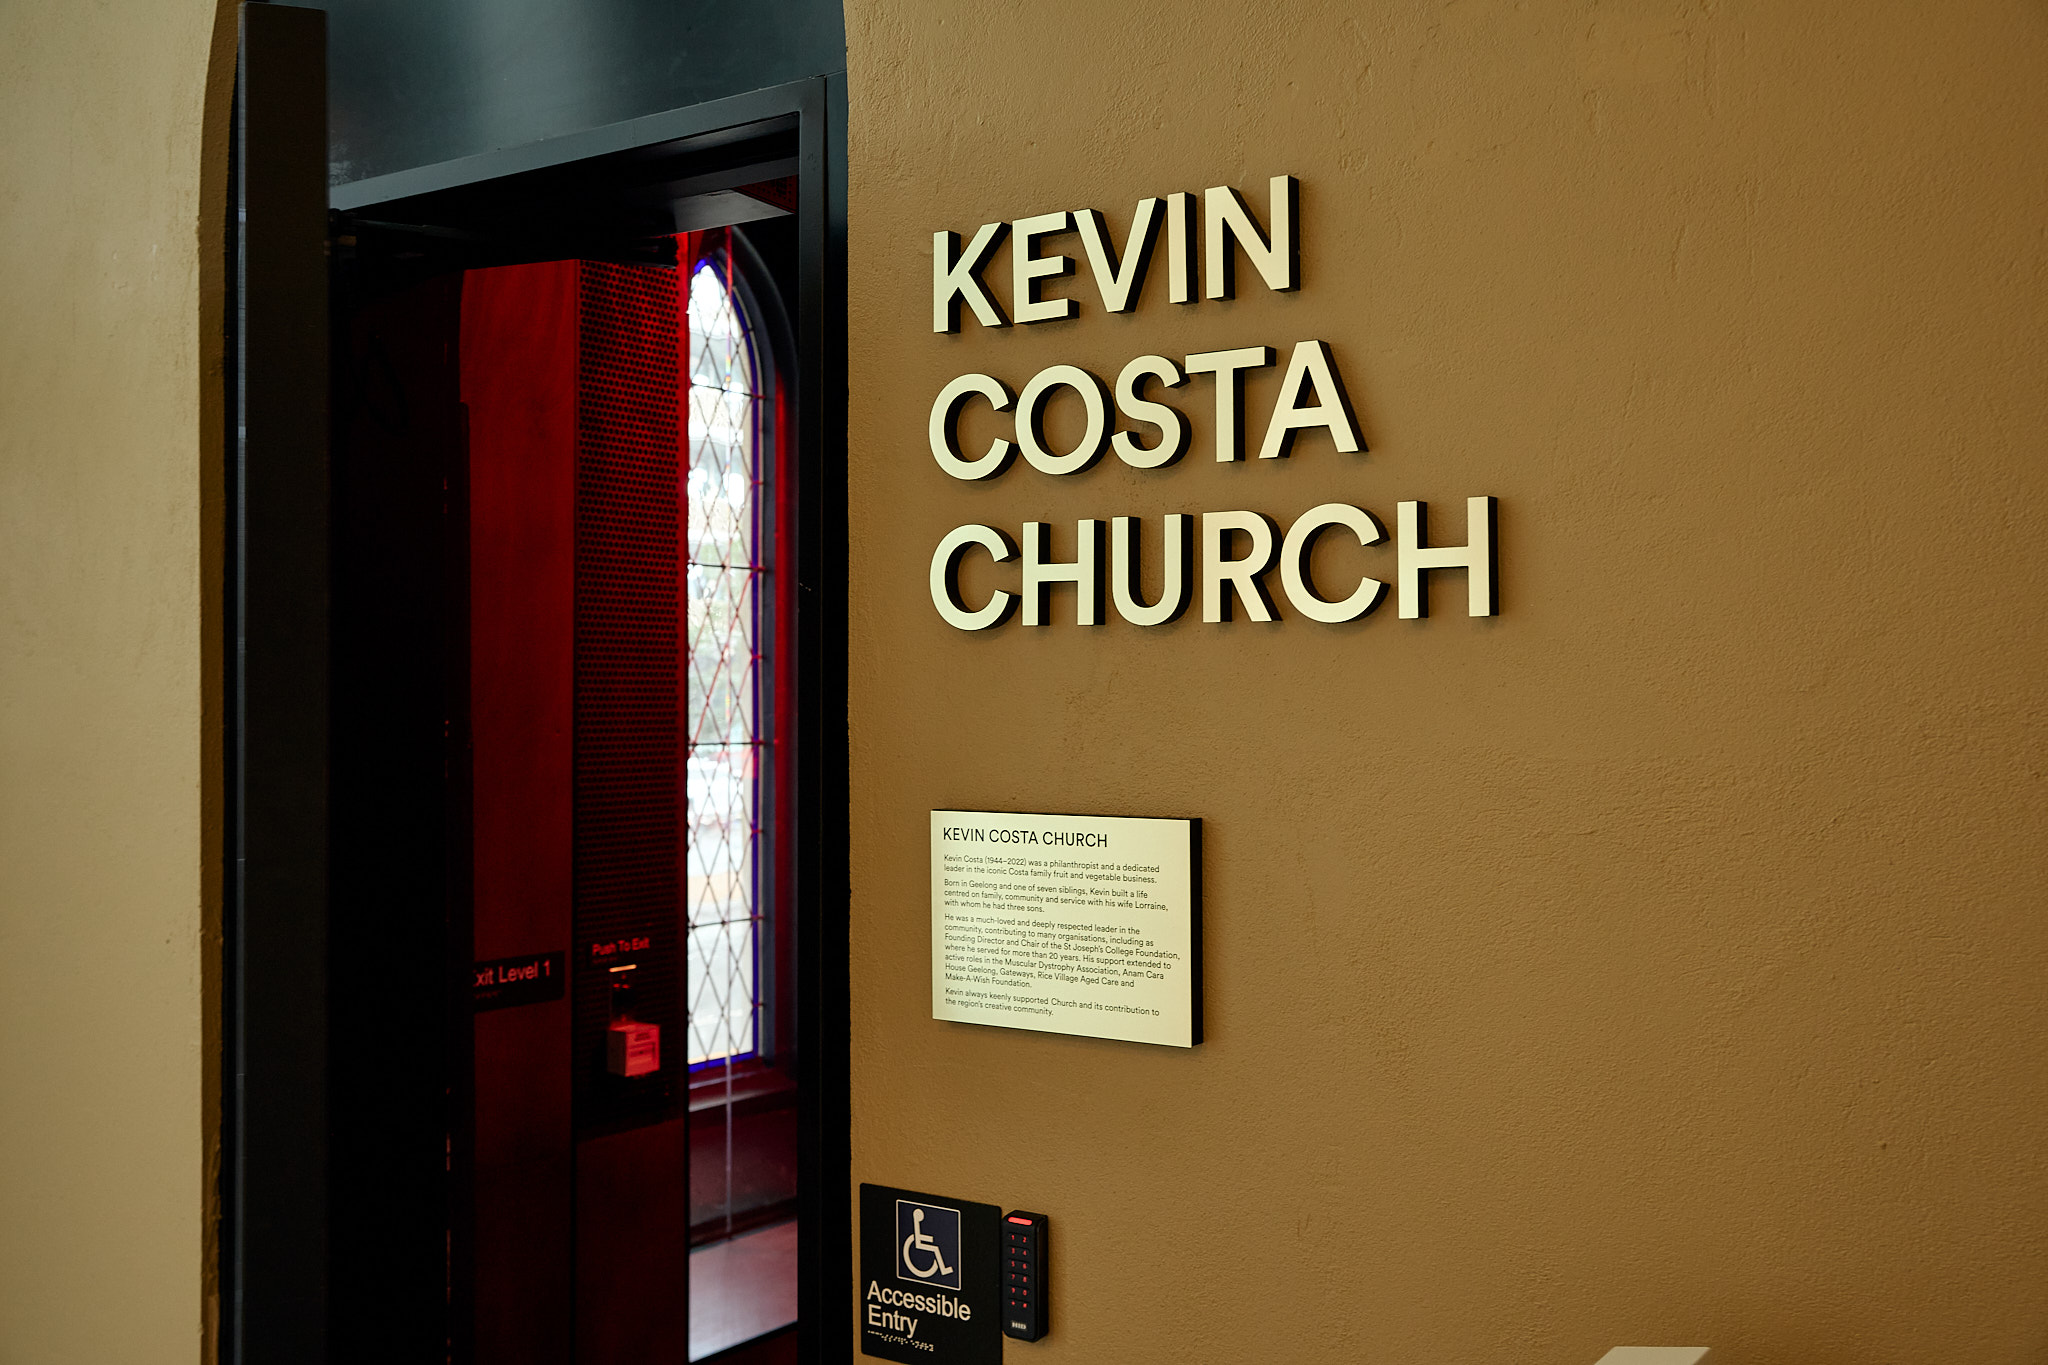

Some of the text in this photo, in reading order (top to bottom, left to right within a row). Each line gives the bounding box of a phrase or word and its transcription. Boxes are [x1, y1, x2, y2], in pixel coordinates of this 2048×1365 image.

[932, 174, 1290, 333] KEVIN
[928, 339, 1359, 481] COSTA
[929, 496, 1491, 631] CHURCH
[943, 827, 1107, 847] KEVIN COSTA CHURCH
[944, 854, 961, 862] Kevin
[963, 855, 983, 863] Costa
[1049, 859, 1099, 871] philanthropist
[1100, 862, 1114, 870] and
[1122, 863, 1159, 873] dedicated
[944, 863, 964, 872] leader
[973, 865, 985, 873] the
[986, 866, 1006, 874] iconic
[1008, 867, 1028, 876] Costa
[1030, 868, 1051, 879] family
[1053, 869, 1068, 878] fruit
[1070, 870, 1083, 879] and
[1084, 871, 1121, 883] vegetable
[1122, 873, 1156, 883] business.
[944, 878, 959, 886] Born
[961, 879, 967, 887] in
[968, 880, 997, 890] Geelong
[998, 881, 1012, 890] and
[1027, 883, 1035, 891] of
[1058, 885, 1088, 896] siblings,
[1089, 887, 1110, 896] Kevin
[1111, 888, 1128, 897] built
[1136, 890, 1148, 898] life
[944, 888, 969, 897] centred
[981, 890, 1003, 901] family,
[1004, 892, 1043, 903] community
[1045, 894, 1058, 903] and
[1060, 895, 1085, 905] service
[1087, 897, 1103, 906] with
[1104, 898, 1115, 907] his
[1117, 899, 1133, 908] wife
[1134, 900, 1168, 911] Lorraine,
[944, 898, 958, 906] with
[960, 899, 981, 908] whom
[982, 900, 991, 908] he
[992, 901, 1005, 909] had
[1006, 902, 1025, 911] three
[944, 912, 954, 921] He
[1016, 918, 1030, 926] and
[1031, 919, 1055, 930] deeply
[1056, 921, 1093, 933] respected
[1094, 923, 1117, 933] leader
[1118, 925, 1126, 934] in
[1127, 926, 1140, 935] the
[944, 922, 983, 934] community,
[984, 925, 1026, 938] contributing
[1027, 929, 1035, 937] to
[1036, 931, 1056, 940] many
[1057, 931, 1108, 944] organisations,
[1109, 935, 1144, 947] including
[944, 932, 975, 944] Founding
[977, 935, 1004, 945] Director
[1006, 937, 1019, 946] and
[1020, 938, 1039, 948] Chair
[1041, 940, 1048, 948] of
[1050, 941, 1062, 949] the
[1063, 942, 1071, 950] St
[1104, 945, 1134, 957] College
[1135, 948, 1180, 960] Foundation,
[944, 942, 965, 951] where
[966, 944, 975, 952] he
[976, 945, 999, 954] served
[1000, 947, 1010, 955] for
[1031, 950, 1047, 958] than
[1048, 951, 1058, 959] 20
[1059, 954, 1081, 963] years.
[1082, 954, 1094, 962] His
[1096, 955, 1125, 967] support
[1126, 957, 1162, 968] extended
[1162, 960, 1171, 969] to
[472, 959, 551, 987] xit Level 1
[945, 952, 1164, 979] active roles in the Muscular Dystrophy Association, Anam Cara
[945, 962, 1134, 987] House Geelong, Gateways, Rice Village Aged Care and
[991, 976, 1032, 988] Foundation.
[945, 987, 1160, 1016] Kevin always keenly supported Church and its contribution to
[945, 996, 956, 1005] the
[984, 1000, 1011, 1011] creative
[1013, 1004, 1054, 1017] community.
[867, 1280, 971, 1321] Accessible
[868, 1304, 918, 1339] Entry
